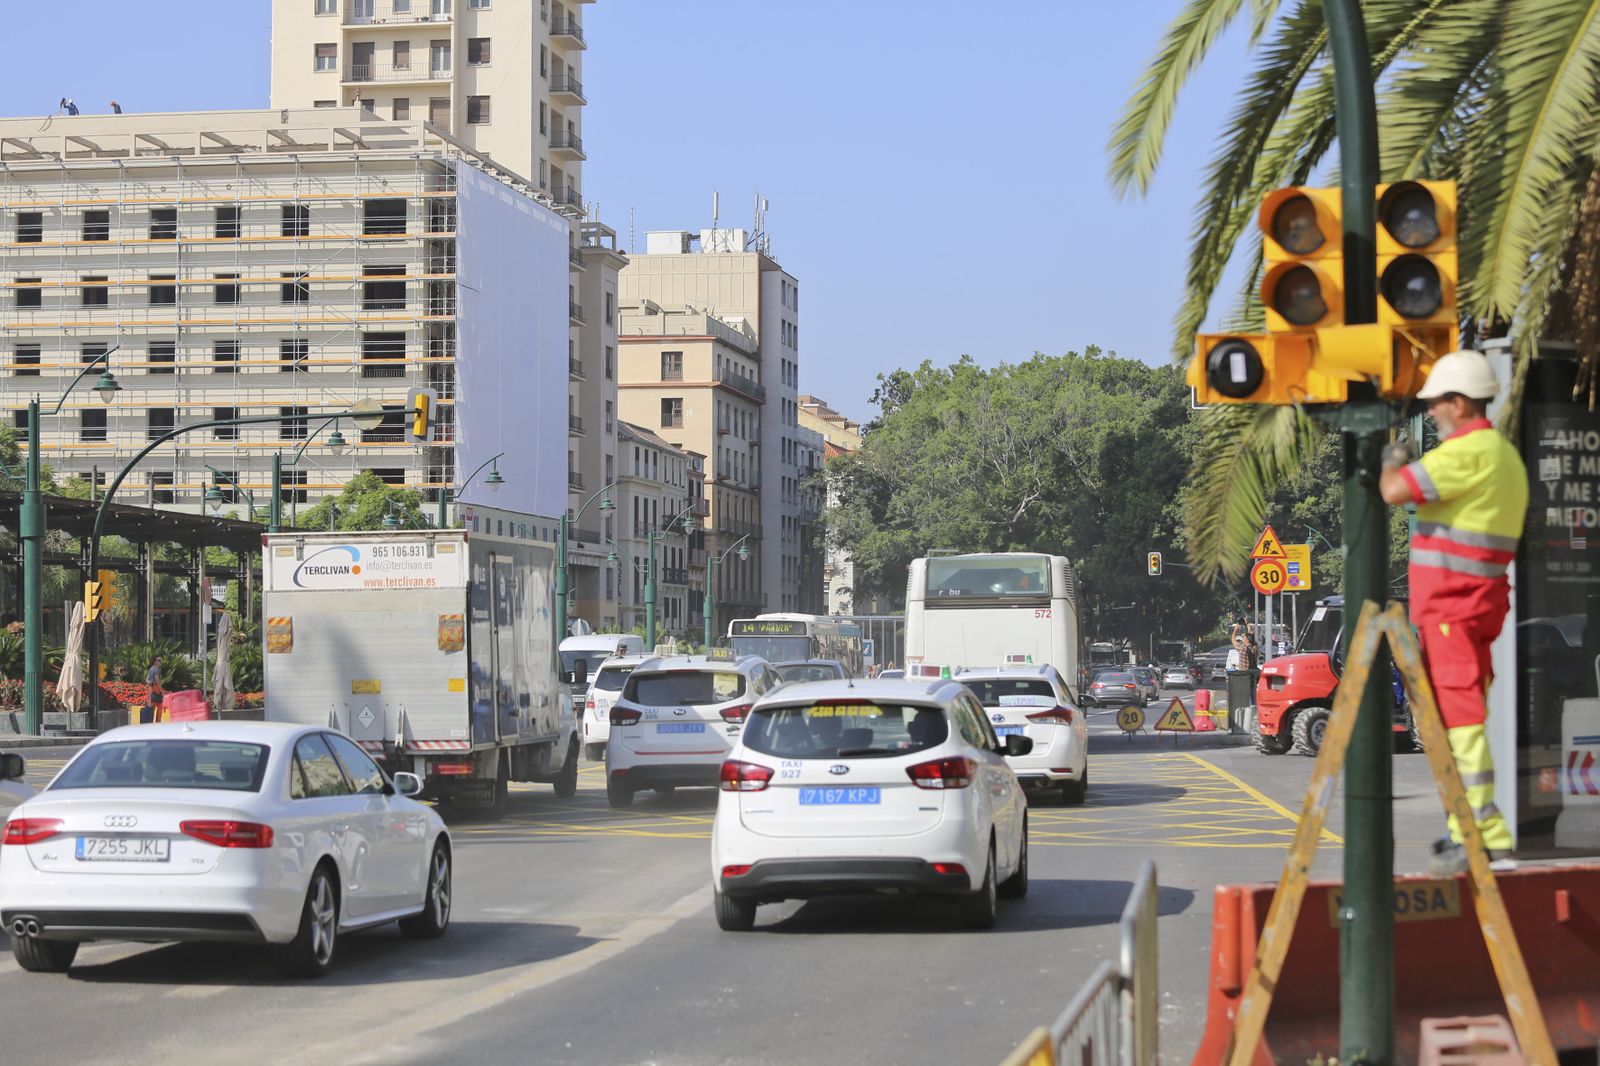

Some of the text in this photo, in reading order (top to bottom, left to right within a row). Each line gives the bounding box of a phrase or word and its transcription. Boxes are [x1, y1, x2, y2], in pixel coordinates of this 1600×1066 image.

[1546, 481, 1557, 500] Y
[1564, 482, 1591, 502] ME
[372, 545, 425, 557] 965 106 931
[304, 565, 350, 575] TERCLIVAN
[366, 560, 433, 571] info@terclivan.es
[364, 576, 436, 587] www.terclivan.es
[1260, 570, 1279, 584] 30
[1034, 609, 1052, 618] 572
[1123, 711, 1139, 724] 20
[781, 760, 803, 768] TAXI
[781, 769, 801, 778] 927
[807, 788, 878, 803] 7167 KPJ
[87, 839, 164, 855] 7255 JKL
